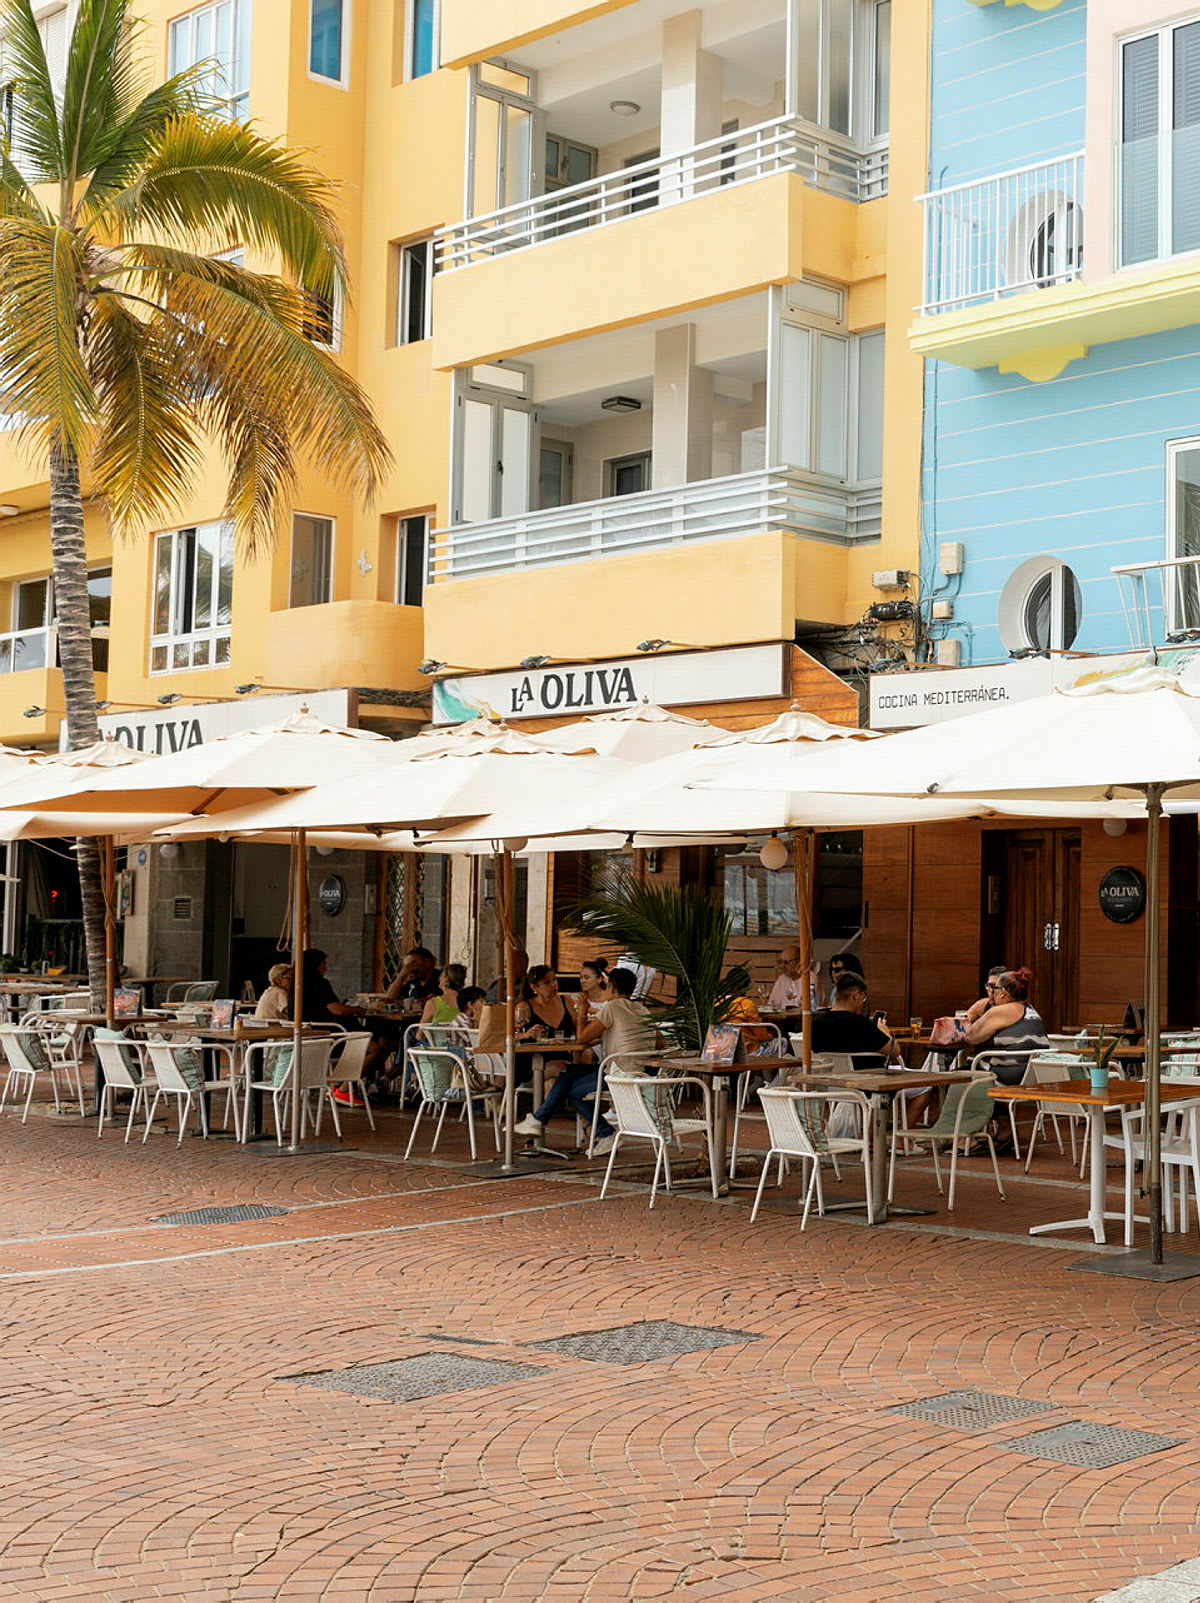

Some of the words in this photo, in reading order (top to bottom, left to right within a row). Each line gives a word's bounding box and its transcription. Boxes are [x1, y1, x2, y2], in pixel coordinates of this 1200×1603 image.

[511, 676, 534, 712] LA
[540, 667, 638, 709] OLIVA
[878, 693, 918, 709] COCINA
[923, 685, 1010, 705] MEDITERRÁNEA.
[1109, 886, 1140, 897] OLIVA
